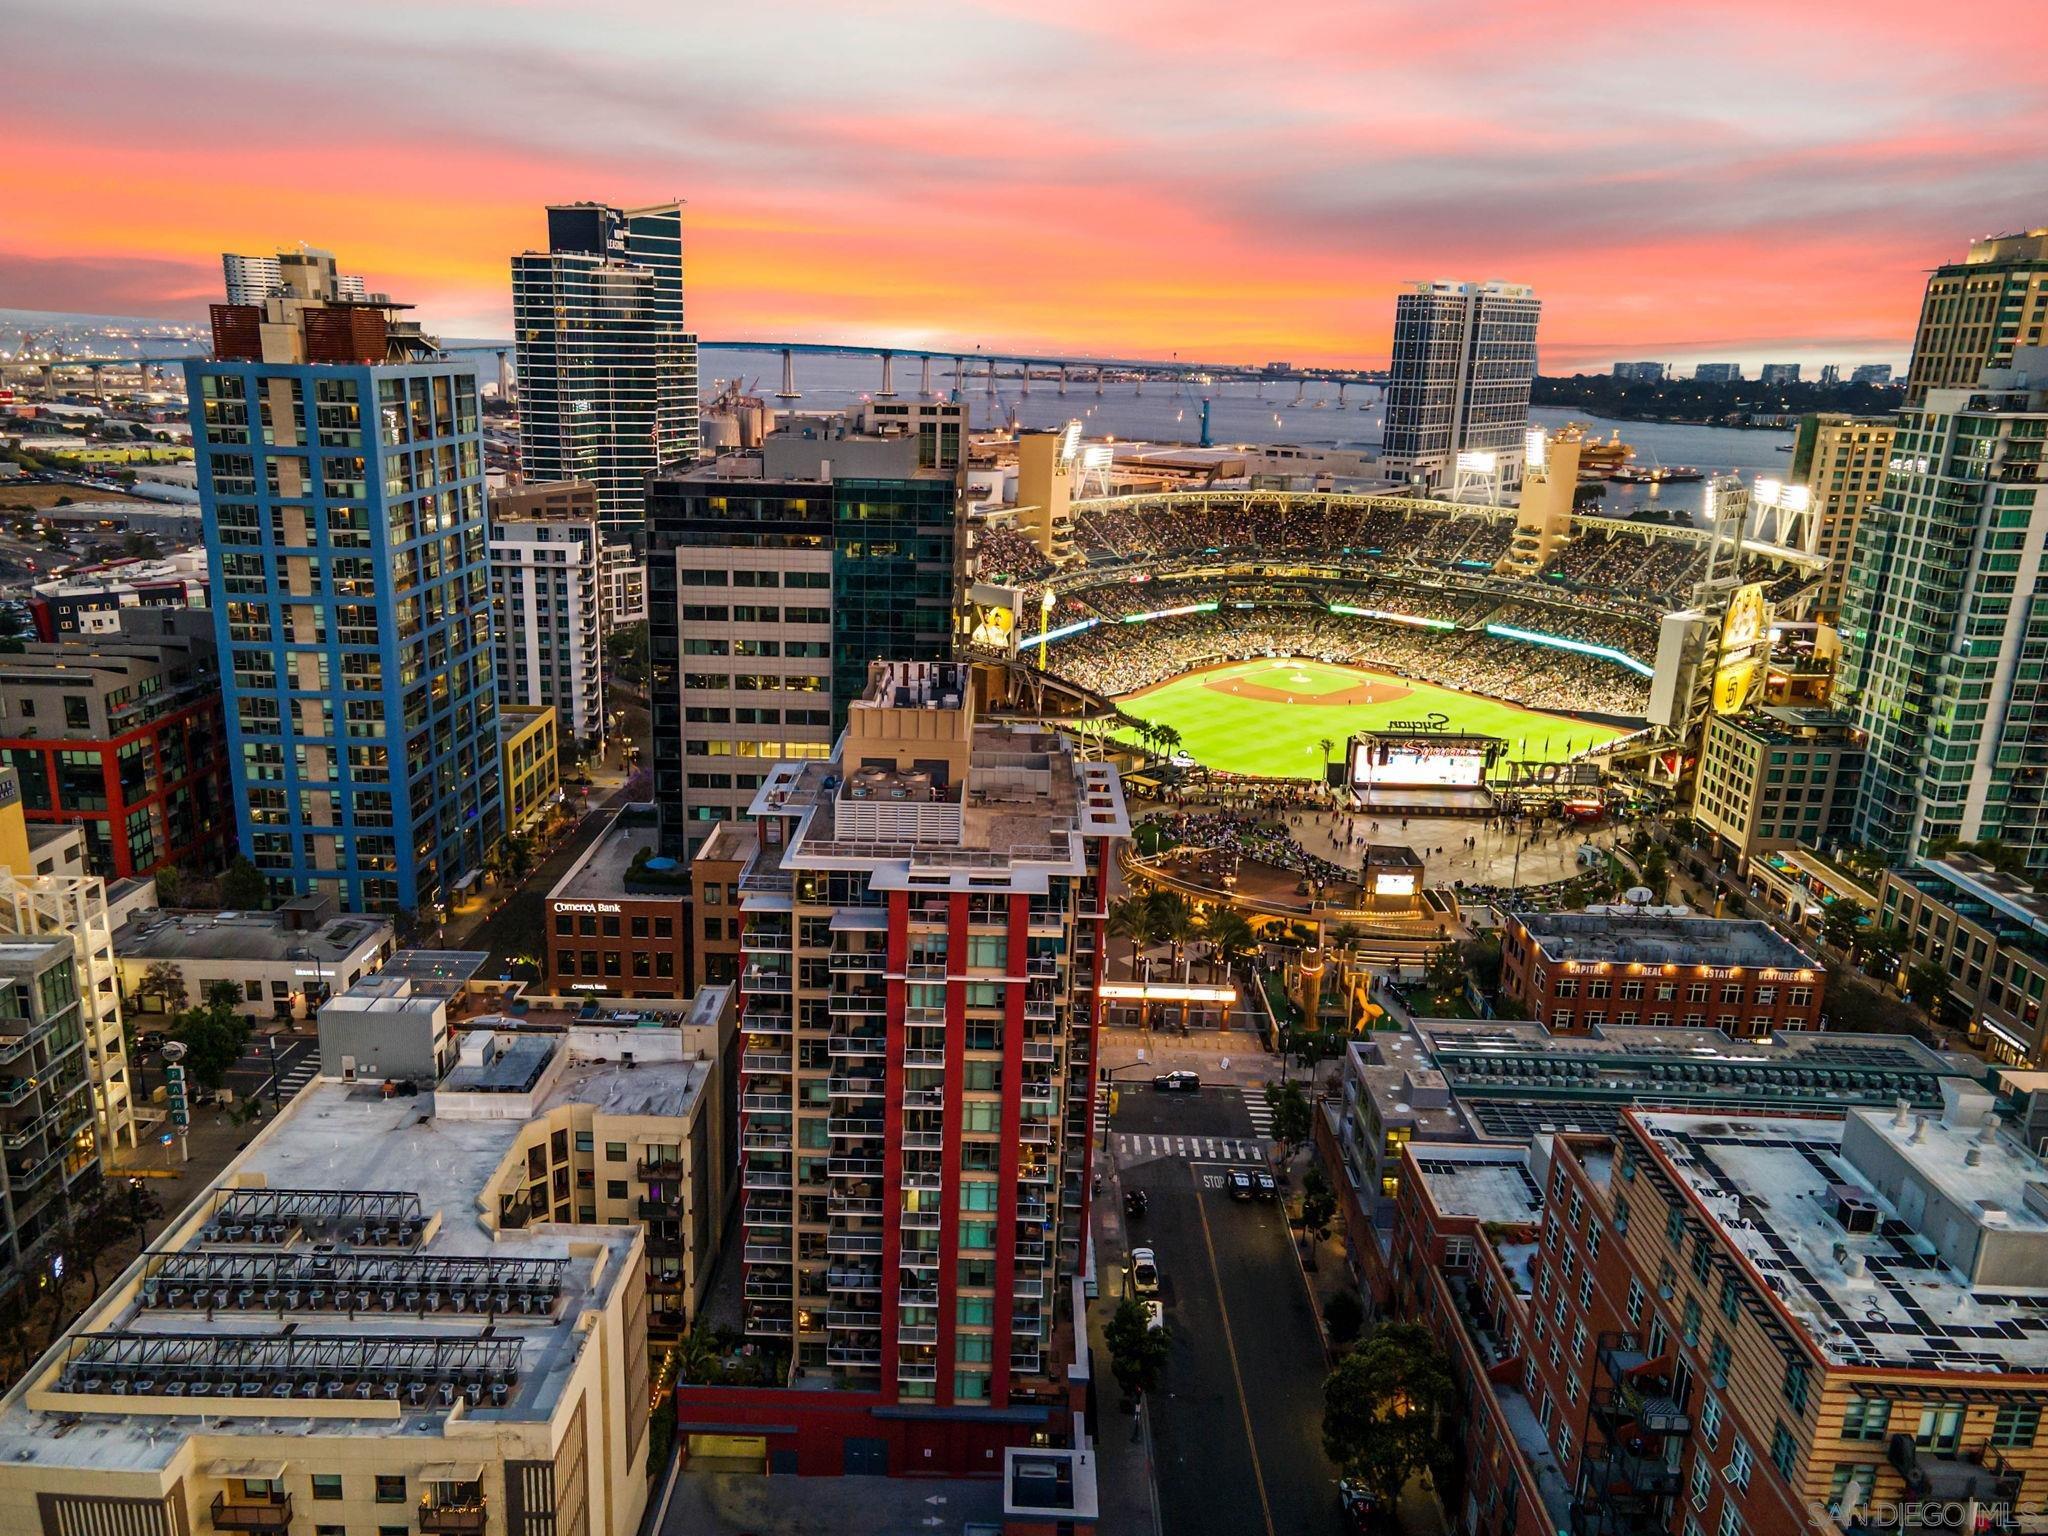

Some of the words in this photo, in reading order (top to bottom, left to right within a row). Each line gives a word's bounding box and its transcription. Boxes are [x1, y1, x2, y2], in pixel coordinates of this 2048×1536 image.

[598, 903, 621, 913] Bank
[1569, 965, 1604, 975] CAPITAL
[1641, 966, 1663, 977] REAL
[1703, 969, 1734, 979] ESTATE
[1758, 971, 1799, 981] VENTURES
[171, 1071, 183, 1123] PARK
[1203, 1175, 1225, 1189] STOP
